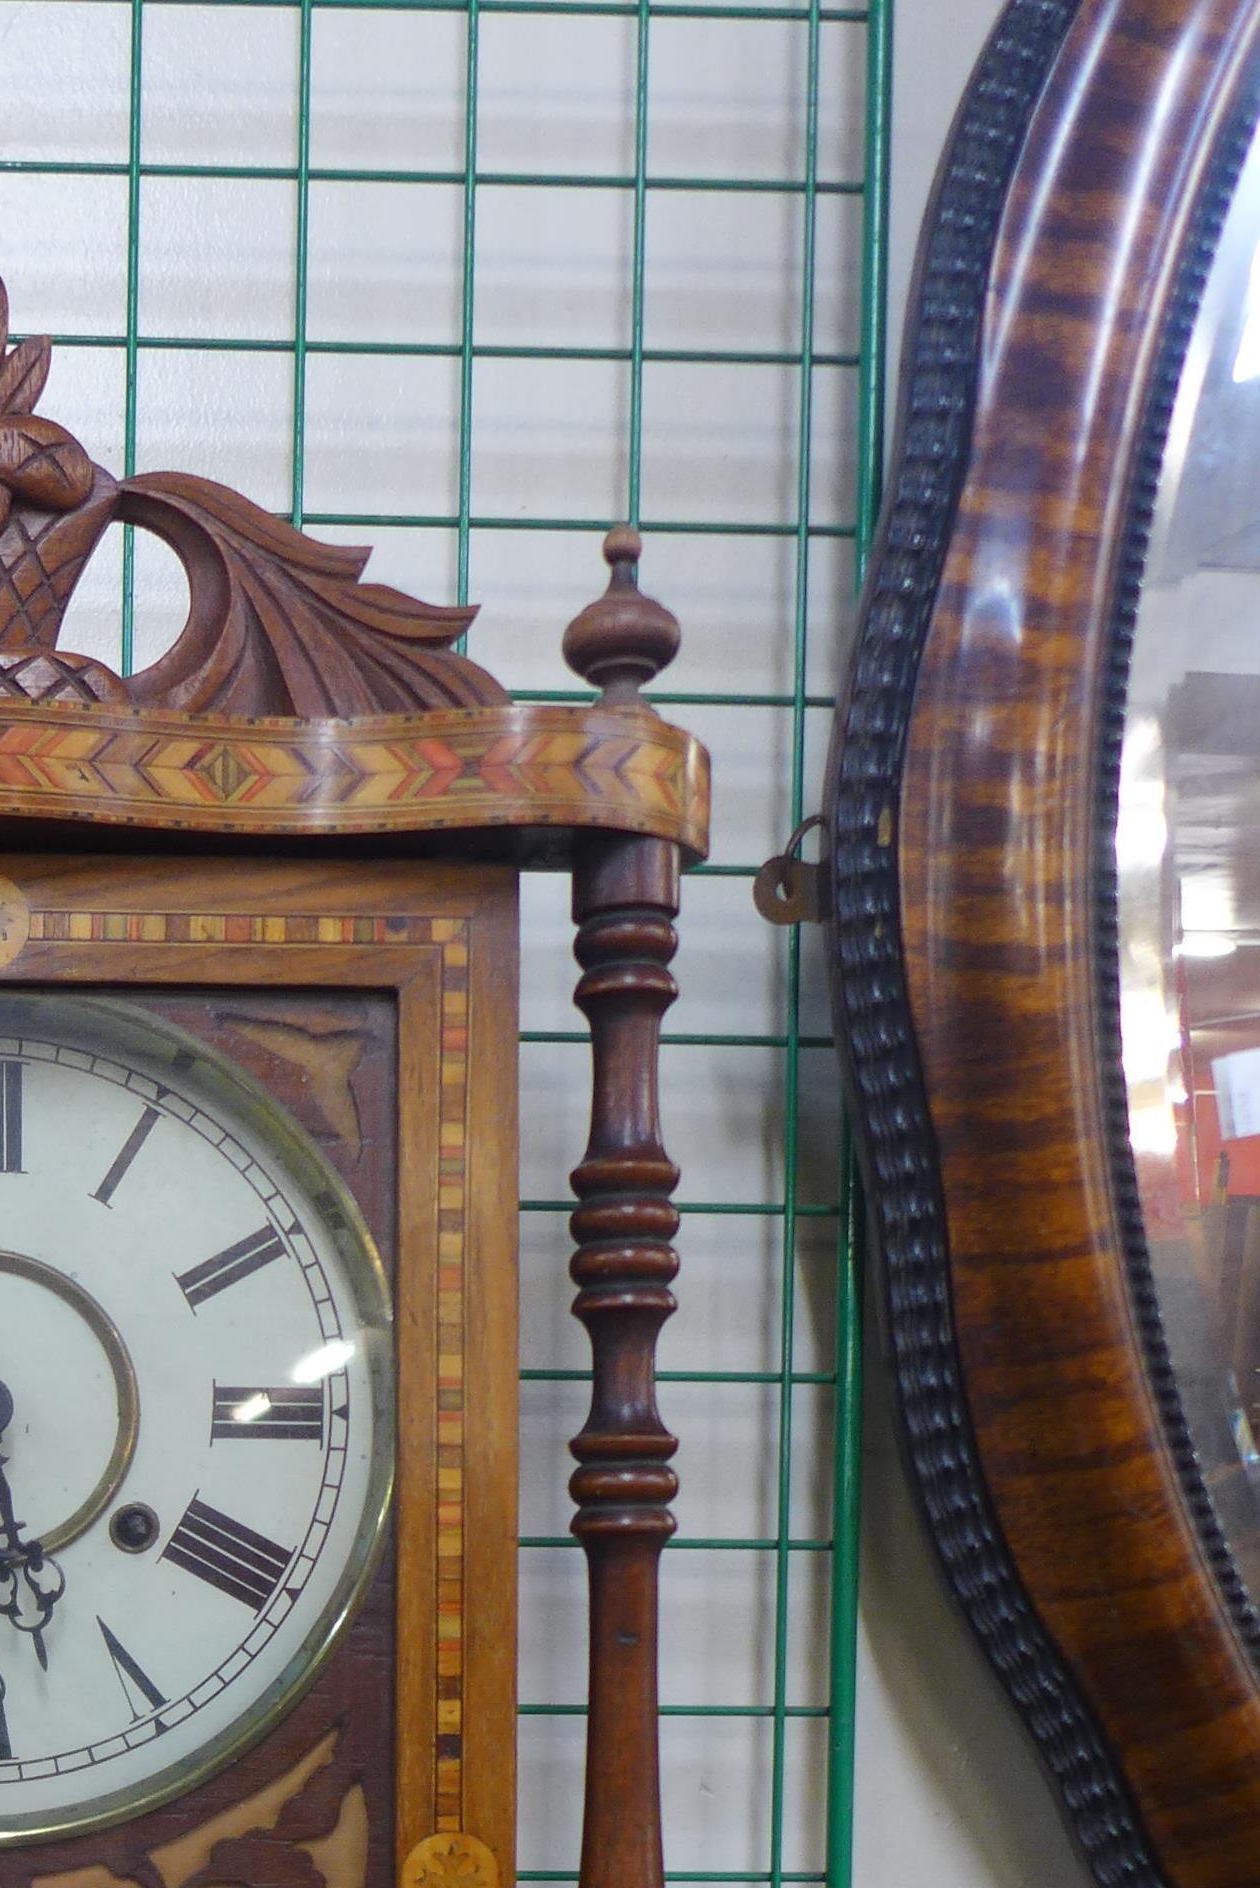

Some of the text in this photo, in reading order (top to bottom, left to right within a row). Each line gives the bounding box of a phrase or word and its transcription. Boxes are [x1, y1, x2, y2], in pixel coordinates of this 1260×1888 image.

[89, 1101, 165, 1208] I
[172, 1218, 291, 1315] II
[210, 1378, 324, 1448] III
[157, 1490, 298, 1618] IIII
[96, 1614, 171, 1724] V
